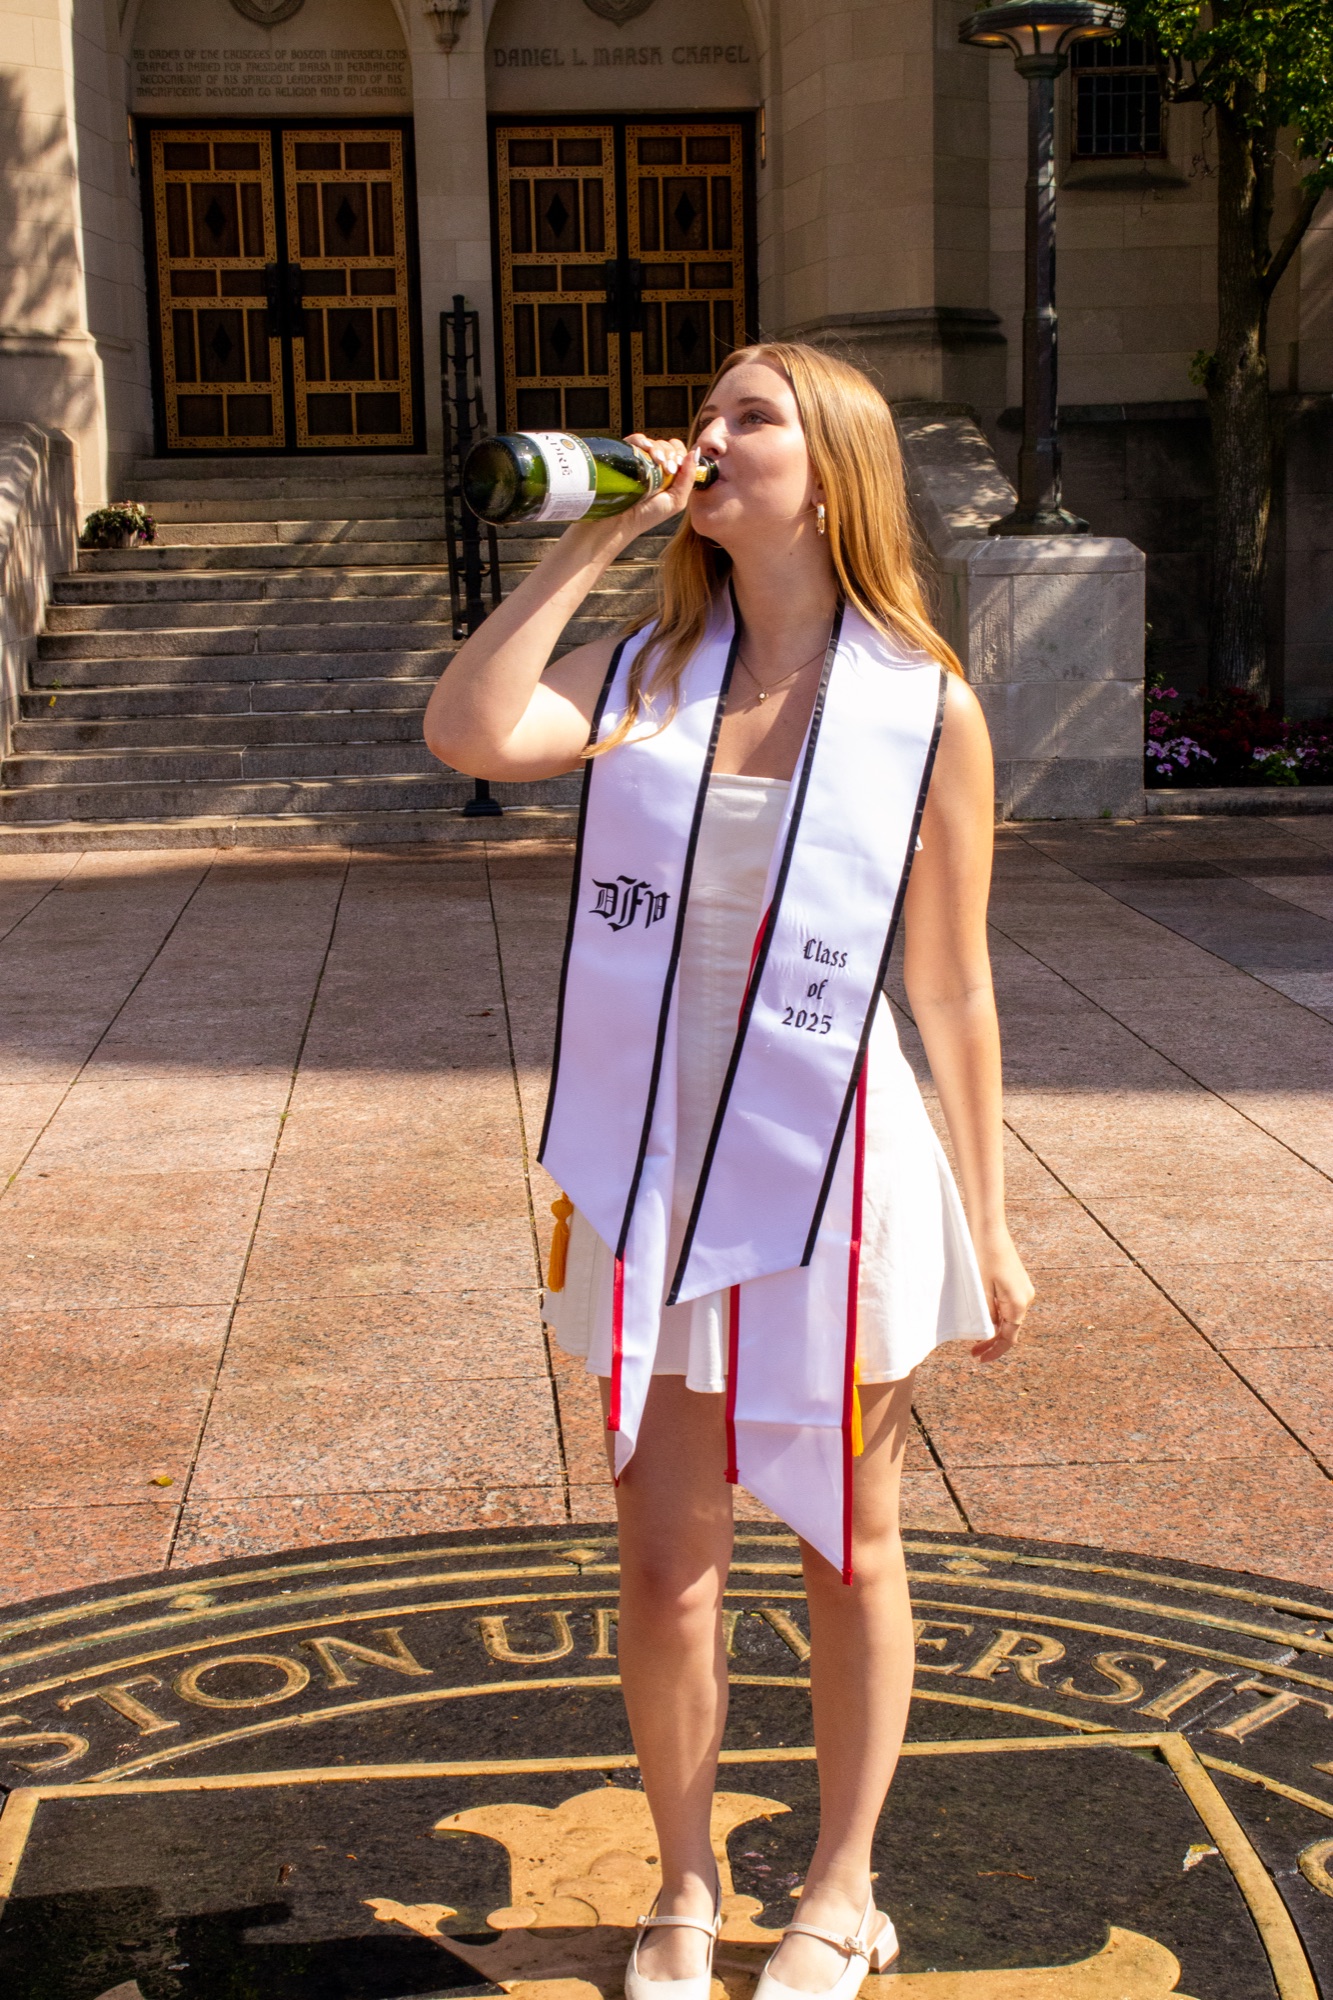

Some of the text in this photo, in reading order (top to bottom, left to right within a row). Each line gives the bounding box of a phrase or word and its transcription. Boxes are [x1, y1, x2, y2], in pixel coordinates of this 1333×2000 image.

[148, 49, 180, 59] ORDER
[184, 49, 195, 59] OF
[200, 49, 218, 59] THE
[223, 49, 270, 59] TRUSTEES
[275, 49, 286, 59] OF
[291, 49, 326, 59] BOSTON
[493, 45, 750, 67] DANIEL L. MARSH CHAPEL
[136, 62, 405, 71] CHAPEL IS NAMED FOR PRESIDENT MARSH IN PERMANENT
[140, 74, 402, 84] RECOGNITION OF HIS SPIRITED LEADERSHIP AND OF HIS
[136, 87, 201, 97] MAGNIFICENT
[205, 87, 253, 97] DEVOTION
[258, 87, 271, 97] TO
[275, 87, 316, 97] RELIGION
[320, 87, 340, 97] AND
[344, 87, 357, 97] TO
[803, 938, 848, 968] Class
[807, 979, 829, 1000] of
[781, 1006, 833, 1035] 2025
